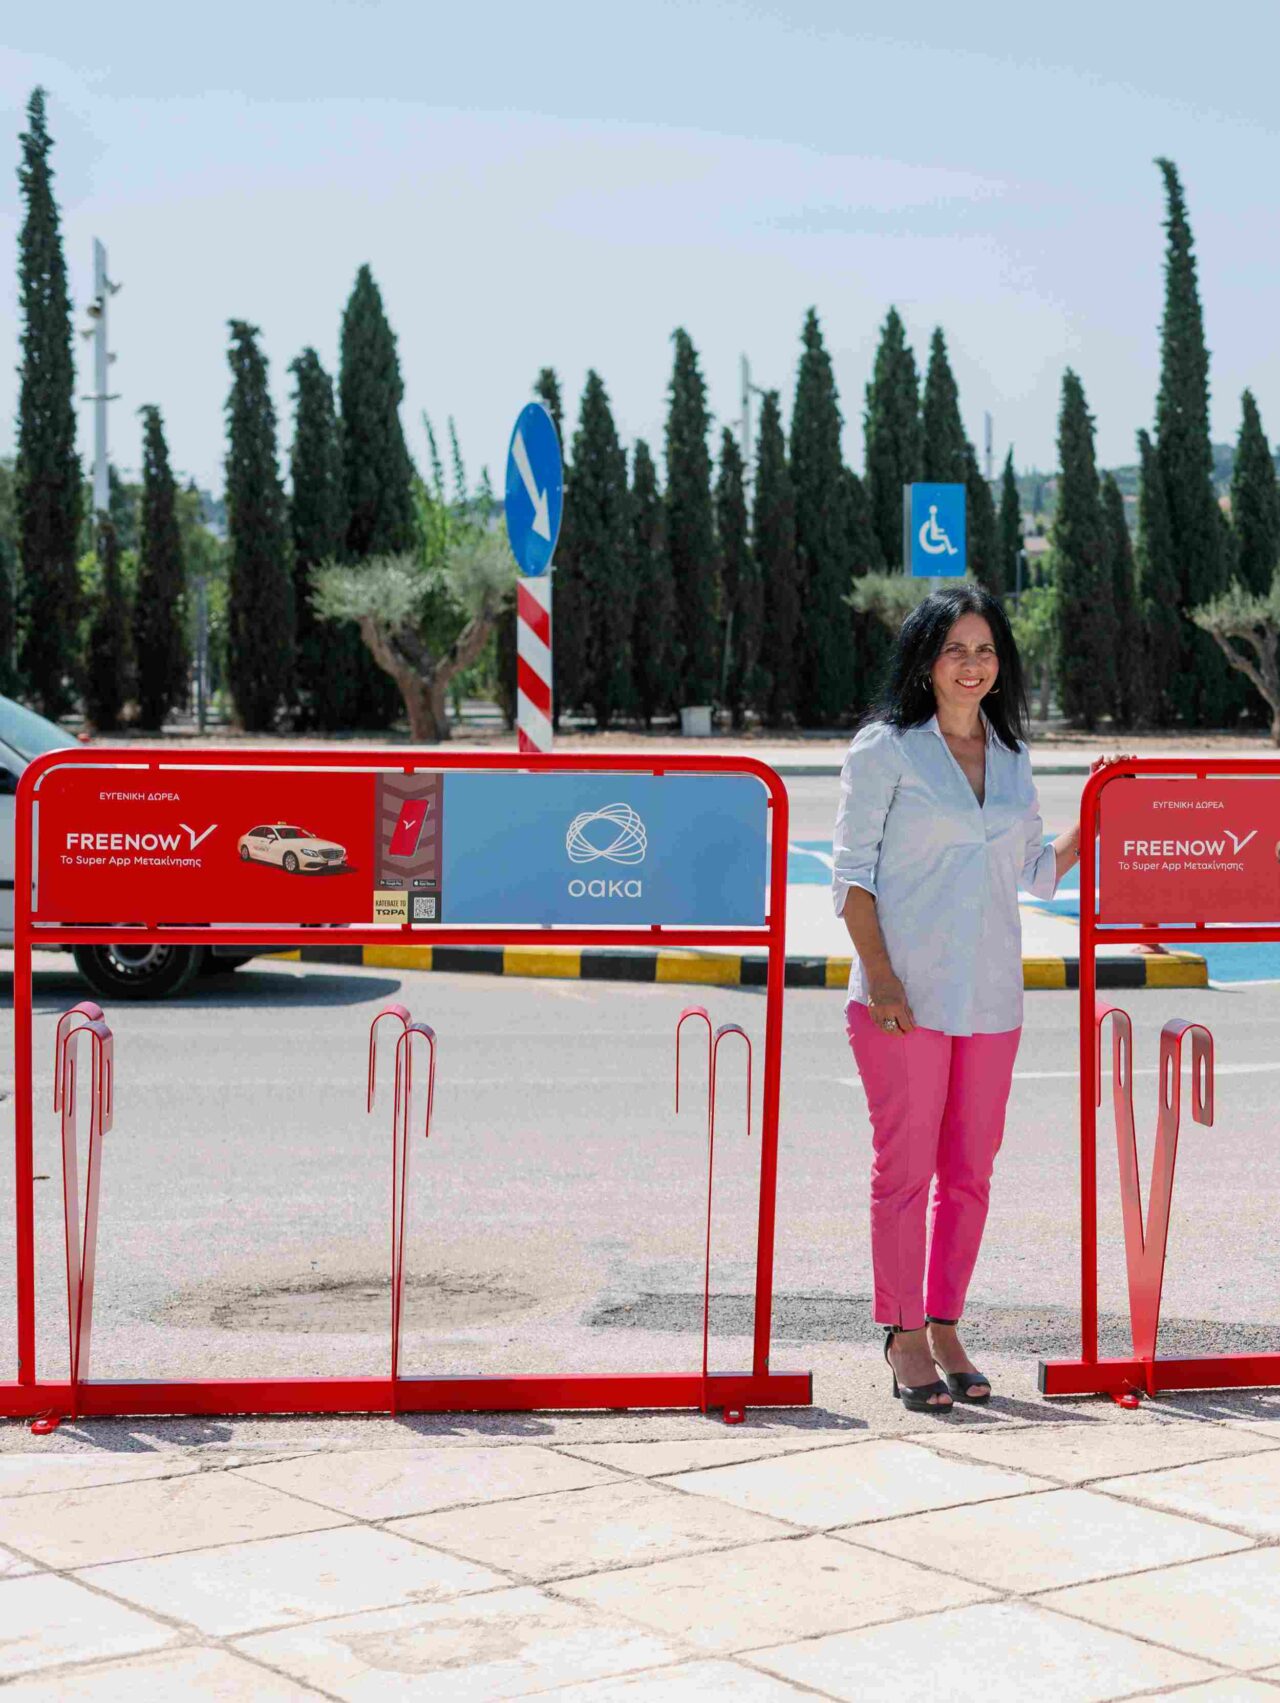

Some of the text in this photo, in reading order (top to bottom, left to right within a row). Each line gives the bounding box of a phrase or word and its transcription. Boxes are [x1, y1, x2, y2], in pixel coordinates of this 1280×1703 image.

[99, 791, 180, 801] ΕΥΓΕΝΙΚΗ ΔΩΡΕΑ
[1152, 800, 1225, 809] ΕΥΓΕΝΙΚΗ ΔΩΡΕΑ
[66, 832, 182, 851] FREENOW
[1123, 840, 1226, 856] FREENOW
[75, 855, 107, 867] Super
[108, 855, 131, 867] App
[133, 855, 202, 868] Μετακίνησης
[1132, 861, 1160, 872] Super
[1161, 861, 1182, 872] App
